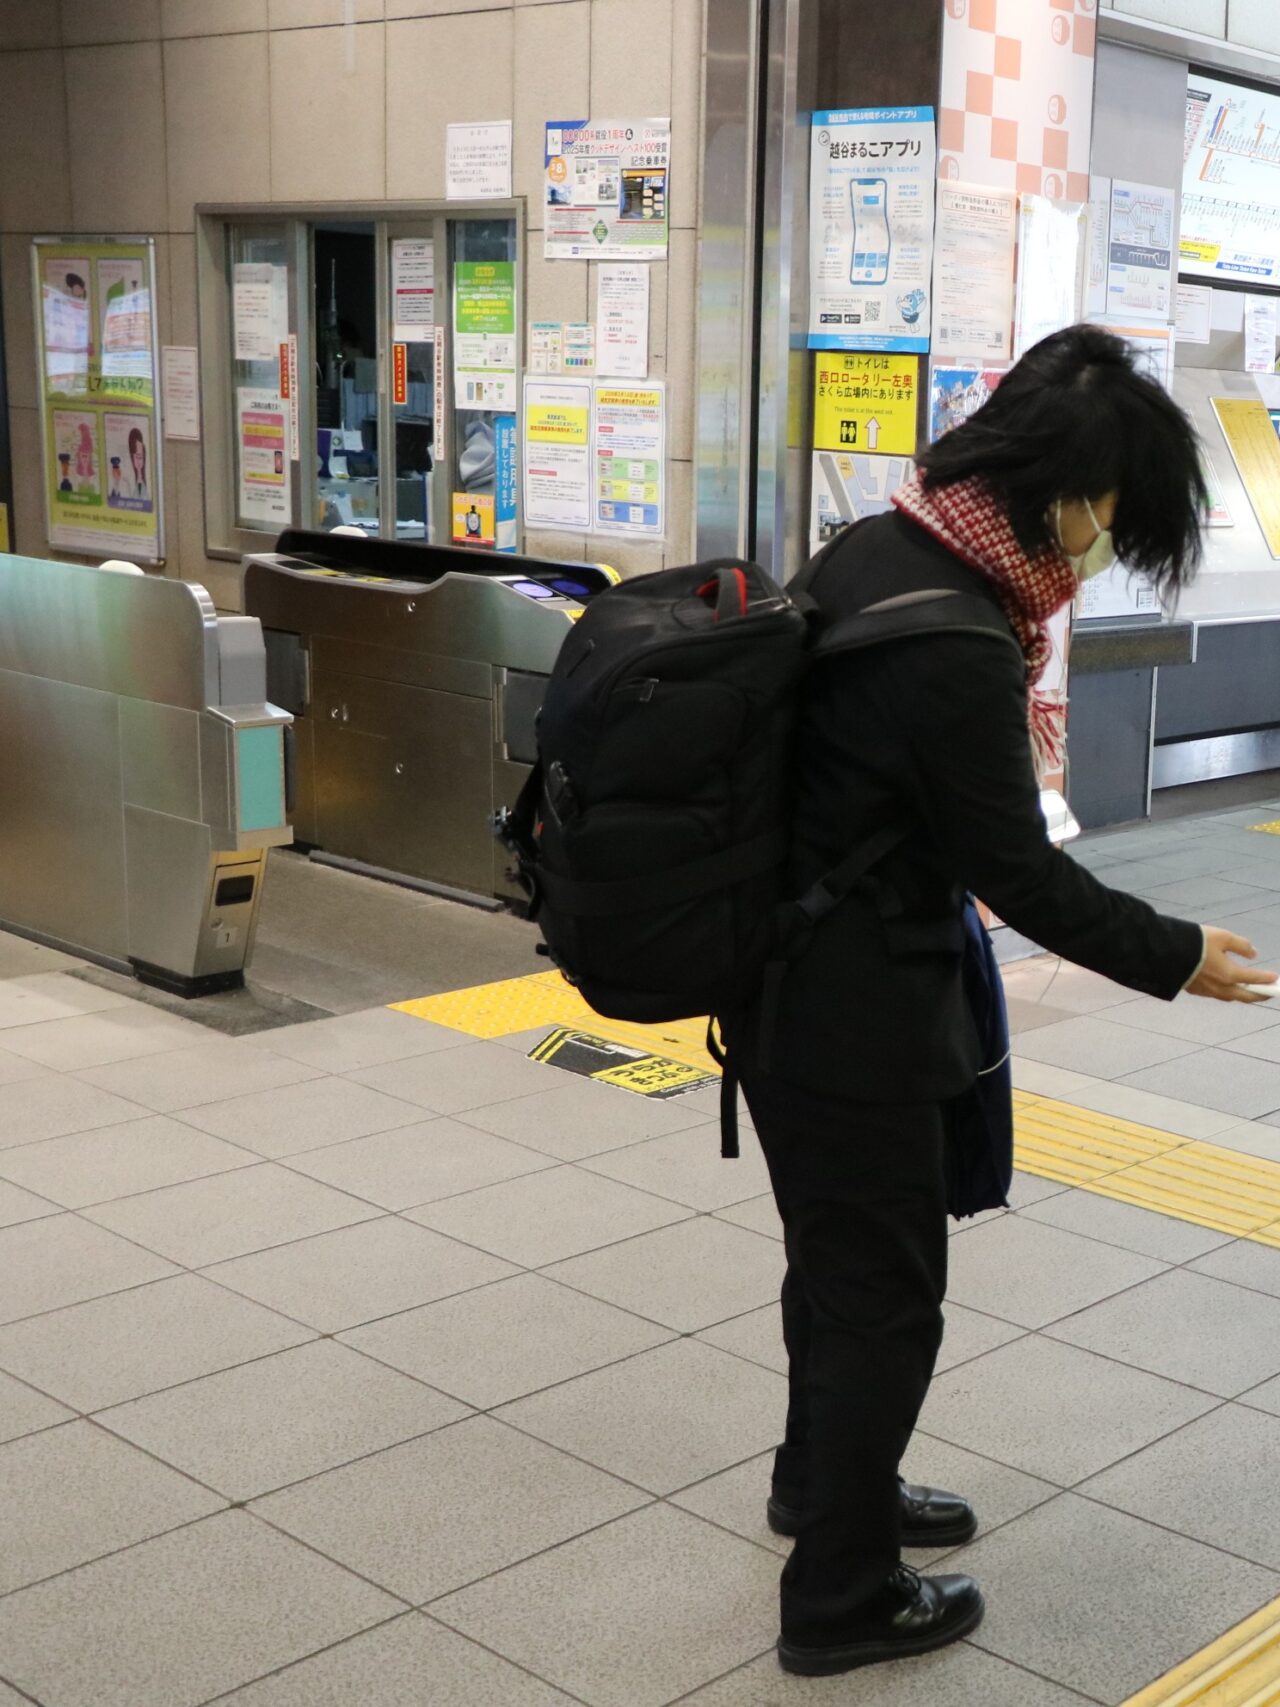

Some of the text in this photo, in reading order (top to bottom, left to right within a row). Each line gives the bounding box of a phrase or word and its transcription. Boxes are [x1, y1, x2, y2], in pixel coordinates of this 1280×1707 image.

[829, 139, 922, 159] 越谷まるこアプリ
[857, 358, 890, 369] トイレは
[819, 371, 913, 388] 西口ロータリー左奥
[818, 385, 913, 401] さくら広場内にあります
